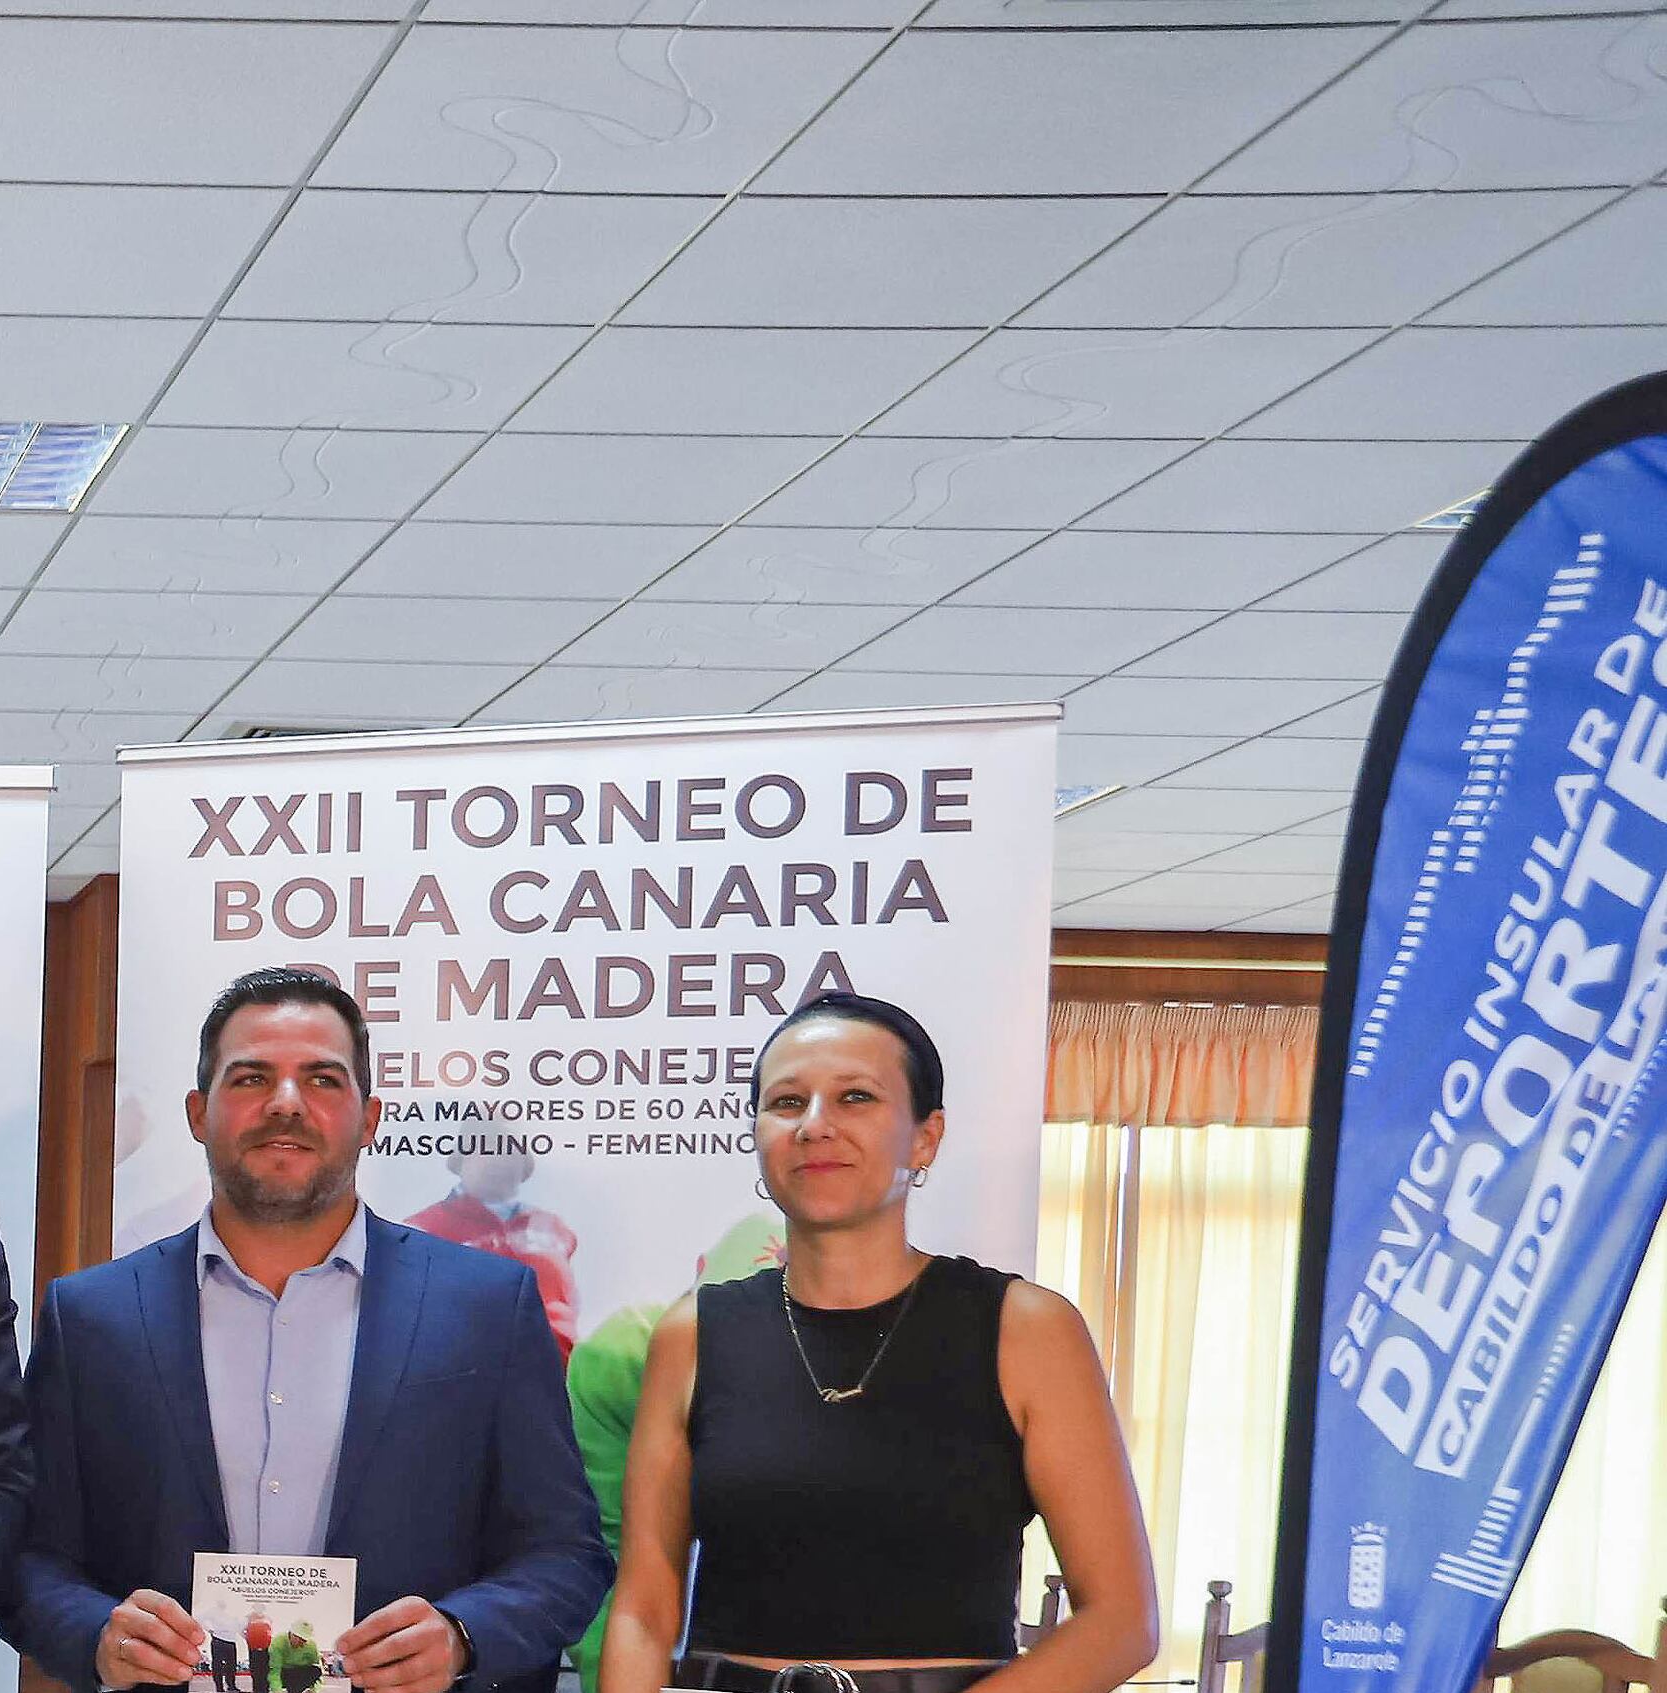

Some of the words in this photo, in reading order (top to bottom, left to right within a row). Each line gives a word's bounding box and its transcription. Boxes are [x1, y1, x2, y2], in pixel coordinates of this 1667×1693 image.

[188, 791, 361, 858] XXII
[396, 773, 805, 850] TORNEO
[844, 767, 973, 836] DE
[212, 873, 461, 942] BOLA
[489, 860, 949, 934] CANARIA
[286, 961, 401, 1022] E
[436, 951, 856, 1021] MADERA
[376, 1050, 511, 1088] ELOS
[529, 1047, 755, 1087] CONEJE
[1330, 1058, 1482, 1391] SERVICIO
[1463, 707, 1621, 1051] INSULAR
[367, 1133, 553, 1157] MASCULINO
[587, 1133, 756, 1155] FEMENINO
[383, 1100, 424, 1122] RA
[435, 1099, 584, 1122] MAYORES
[596, 1099, 636, 1120] DE
[647, 1099, 684, 1121] 60
[1436, 1183, 1563, 1467] CABILDO
[1567, 1074, 1620, 1169] DE
[220, 1565, 246, 1575] XXII
[250, 1566, 306, 1577] TORNEO
[309, 1568, 327, 1579] DE
